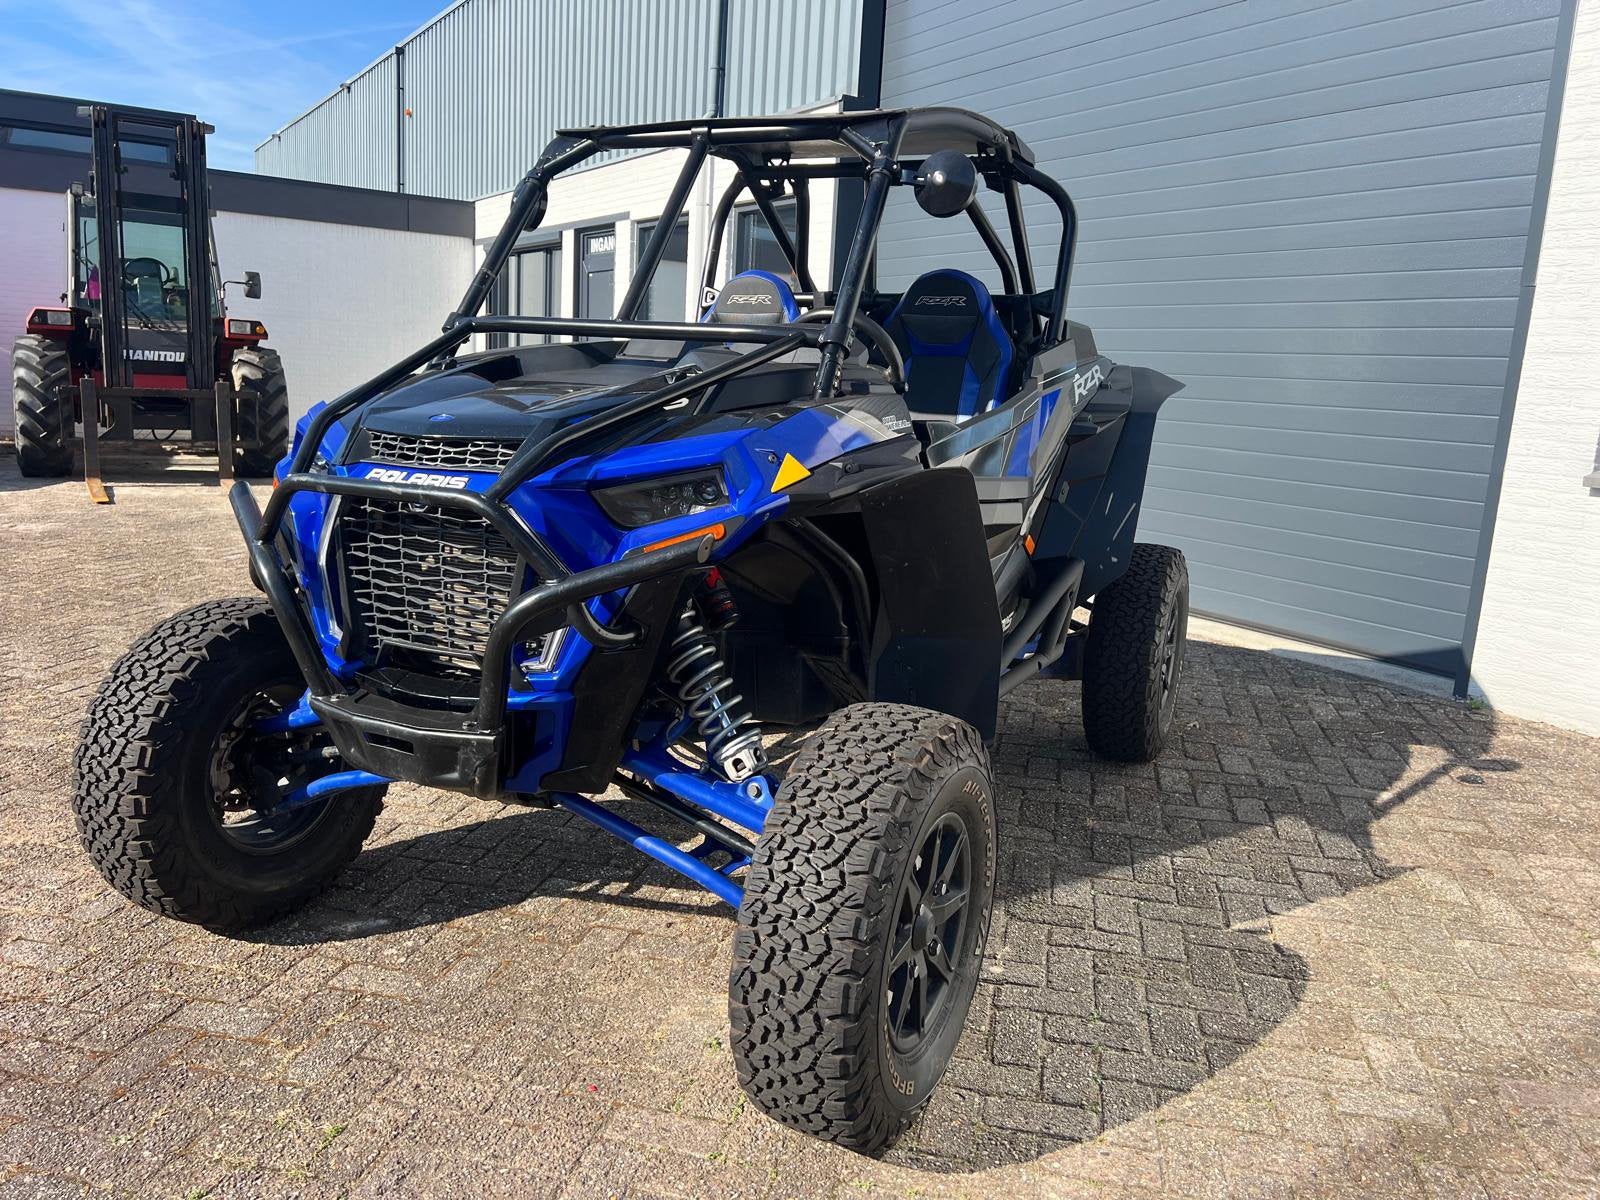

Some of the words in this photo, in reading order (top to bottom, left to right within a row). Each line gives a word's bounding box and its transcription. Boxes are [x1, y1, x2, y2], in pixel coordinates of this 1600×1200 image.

[591, 235, 616, 253] INGAN
[727, 294, 772, 305] RZR
[914, 295, 967, 306] RZR
[1073, 365, 1104, 405] RZR
[364, 468, 470, 489] POLARIS
